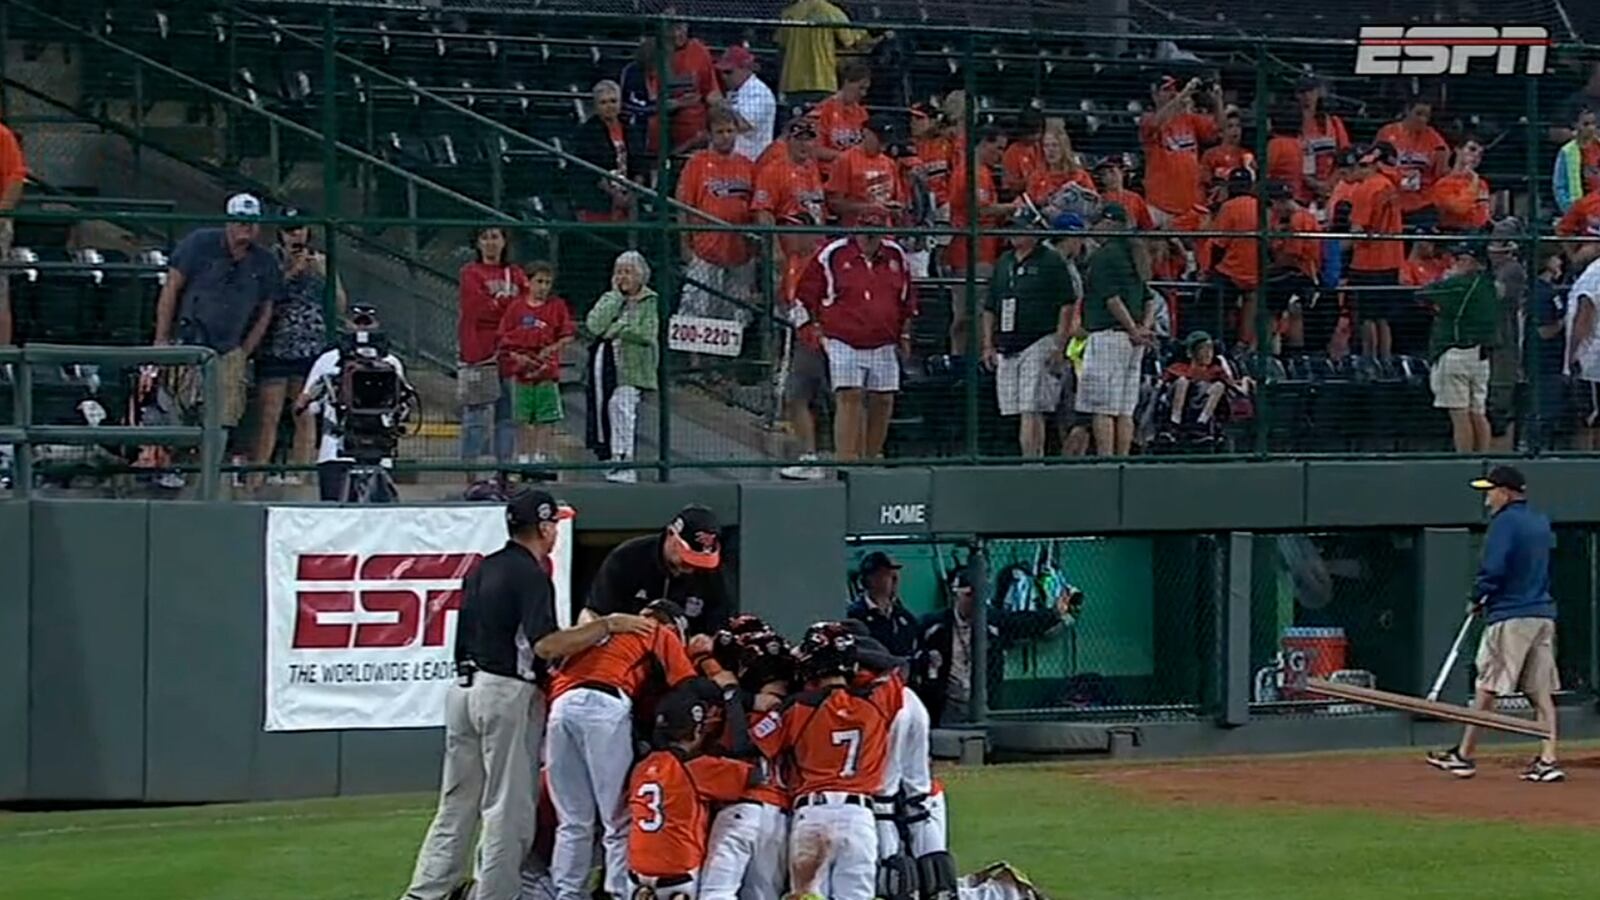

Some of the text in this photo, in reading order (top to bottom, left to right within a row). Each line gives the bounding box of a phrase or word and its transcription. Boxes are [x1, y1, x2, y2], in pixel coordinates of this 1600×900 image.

[881, 504, 925, 523] HOME
[292, 553, 485, 648] ESP
[289, 663, 317, 683] THE
[322, 661, 409, 682] WORLDWIDE
[831, 728, 861, 777] 7
[637, 782, 664, 832] 3
